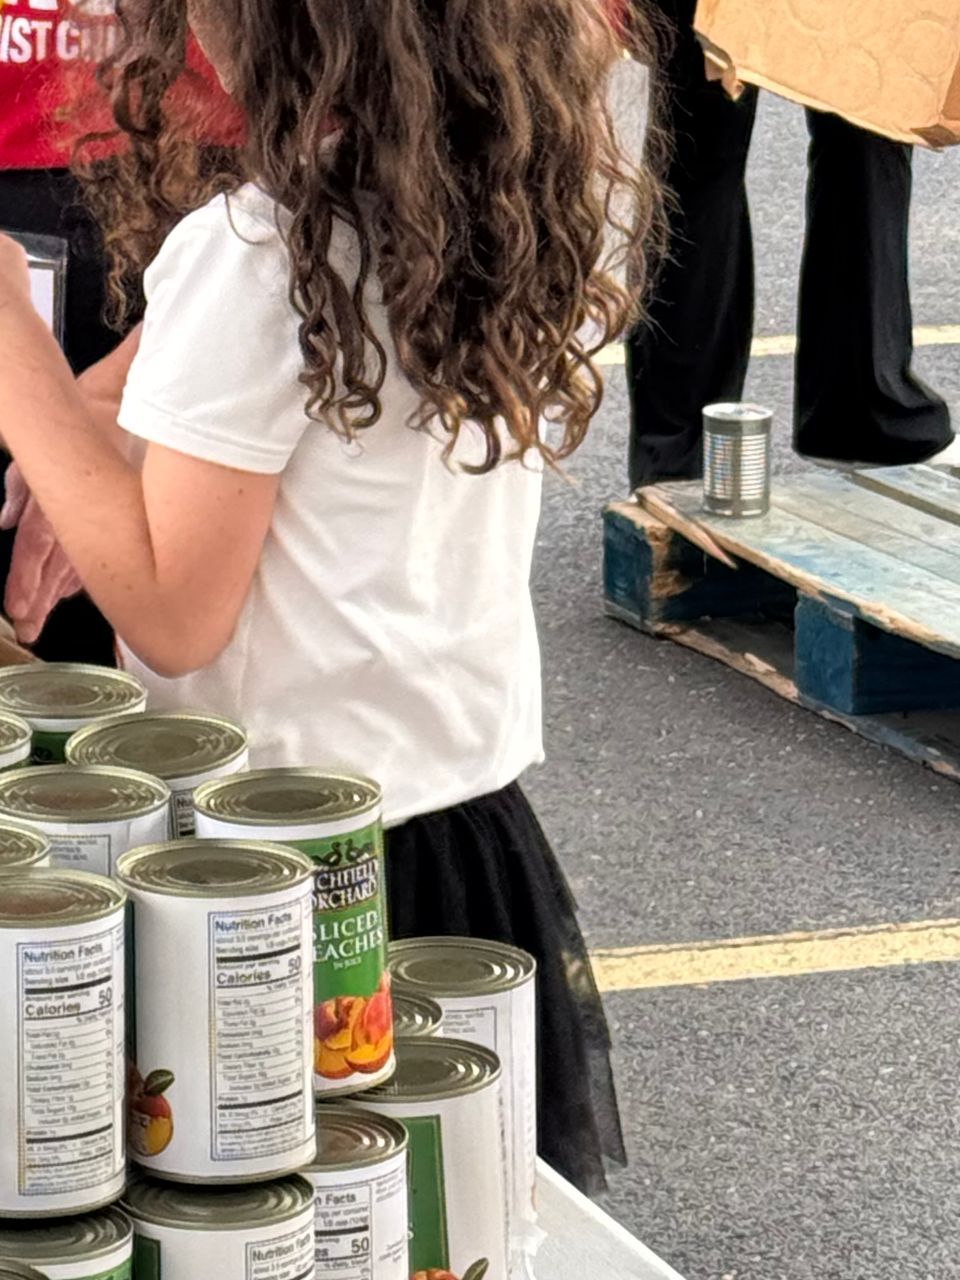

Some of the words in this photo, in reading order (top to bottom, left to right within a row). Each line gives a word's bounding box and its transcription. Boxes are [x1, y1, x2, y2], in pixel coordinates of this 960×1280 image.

[215, 919, 265, 932] Nutrition
[313, 925, 383, 962] EACHES
[24, 950, 75, 962] Nutrition
[216, 970, 271, 985] Calories
[288, 955, 301, 974] 50
[25, 1002, 81, 1016] Calories
[98, 987, 113, 1007] 50
[325, 1192, 356, 1206] Facts
[252, 1242, 295, 1261] Nutrition
[351, 1237, 370, 1254] 50
